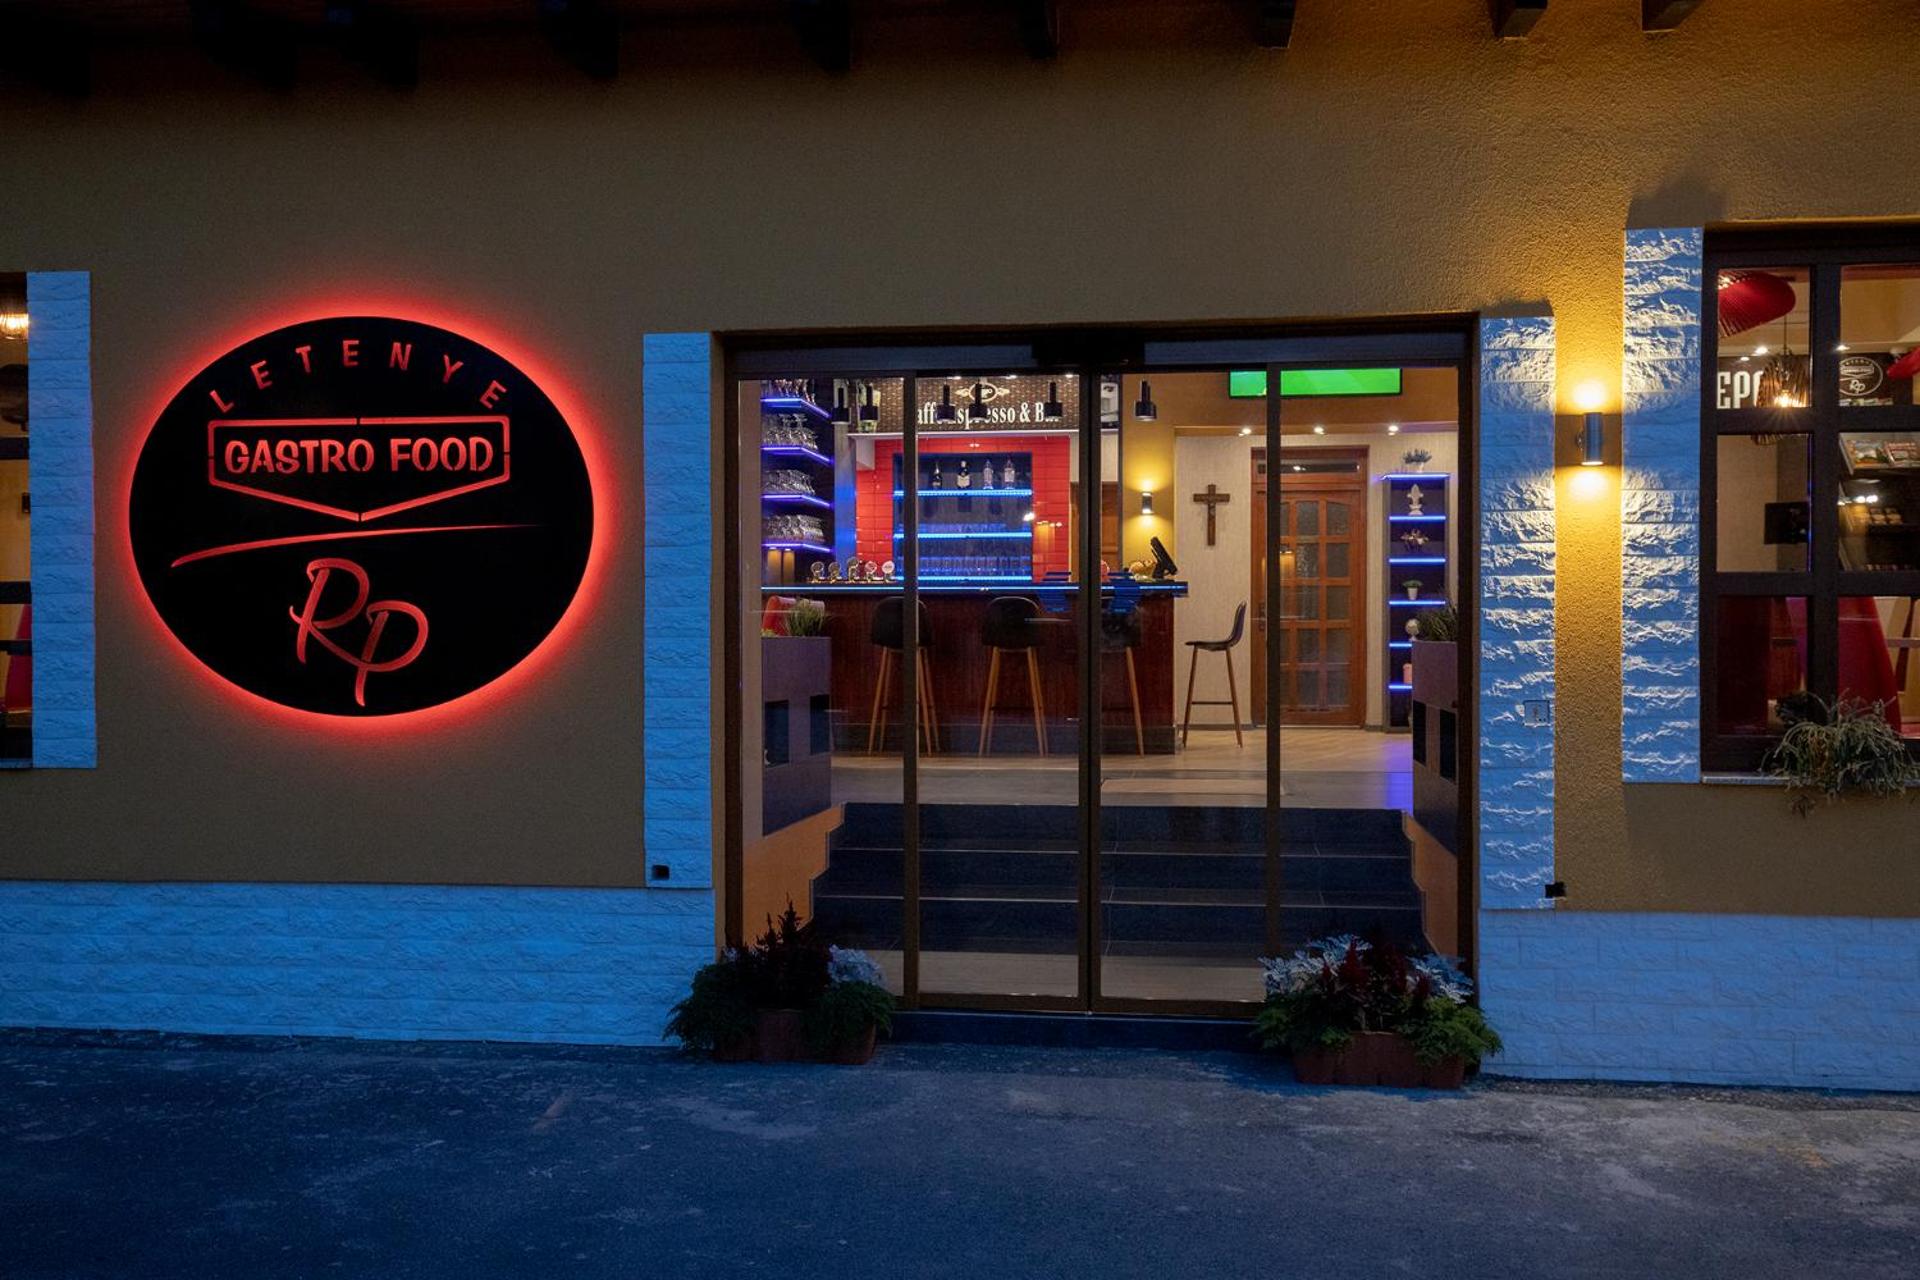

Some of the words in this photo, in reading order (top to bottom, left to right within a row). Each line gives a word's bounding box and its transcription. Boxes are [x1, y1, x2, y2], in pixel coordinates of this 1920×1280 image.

[209, 339, 507, 414] LETENYE
[1019, 402, 1031, 423] &
[224, 438, 375, 474] GASTRO
[390, 436, 494, 472] FOOD
[289, 557, 430, 707] RP
